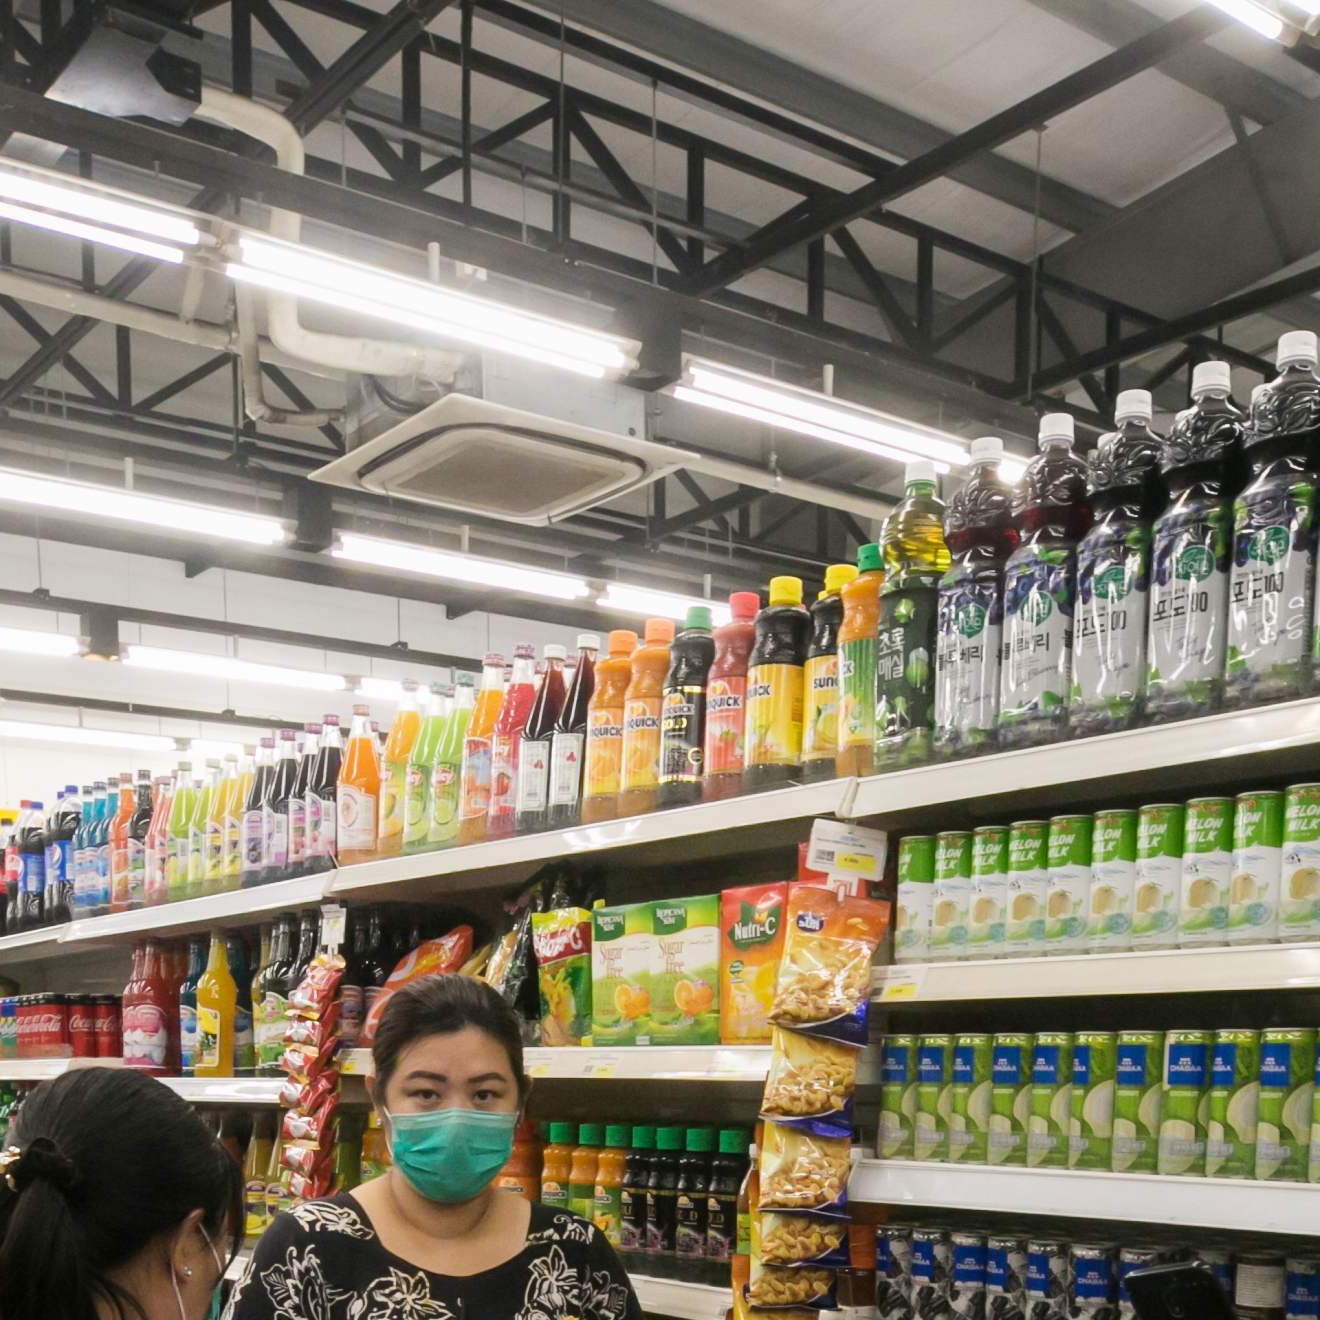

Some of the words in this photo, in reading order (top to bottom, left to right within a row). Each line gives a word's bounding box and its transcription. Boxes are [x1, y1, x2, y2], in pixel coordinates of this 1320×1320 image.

[1152, 590, 1209, 623] 포도00
[1075, 609, 1127, 640] 포도00
[735, 920, 776, 938] Nutri-C
